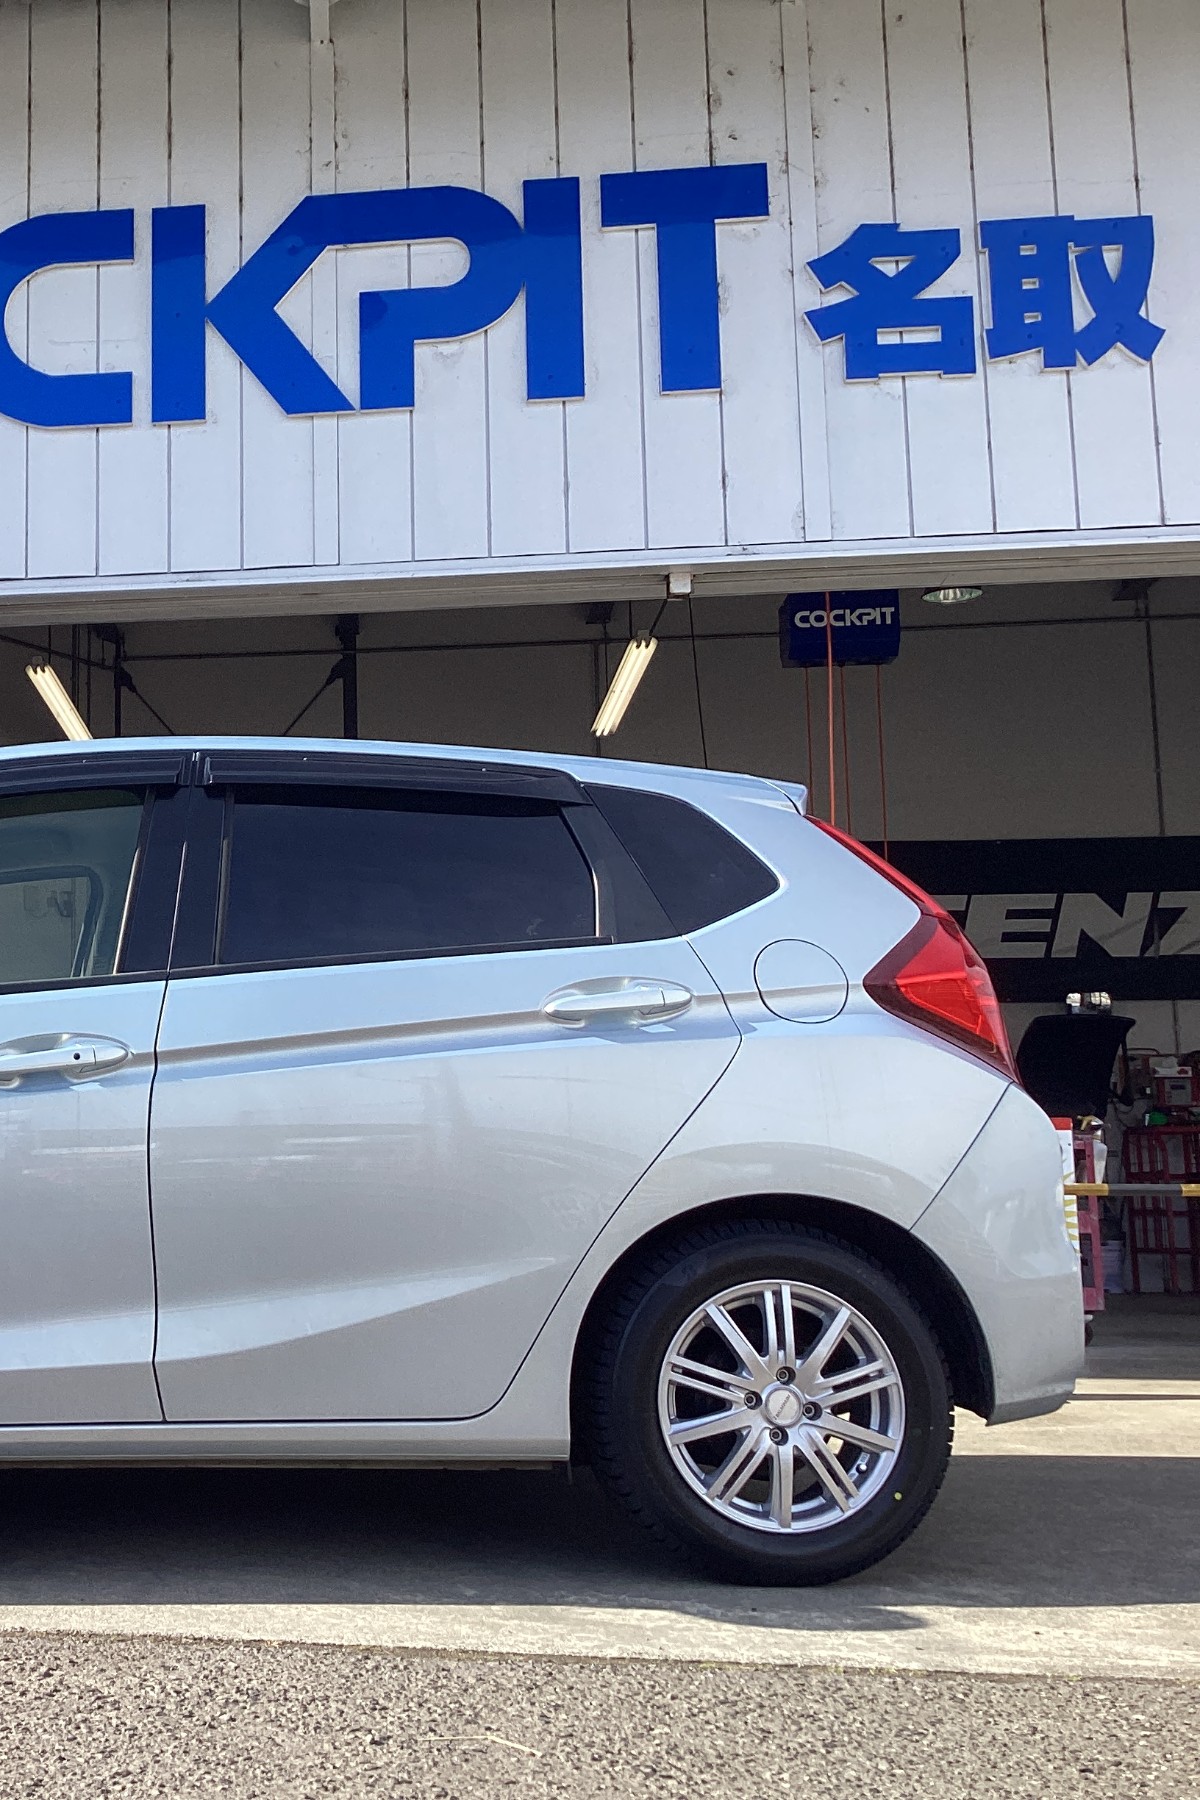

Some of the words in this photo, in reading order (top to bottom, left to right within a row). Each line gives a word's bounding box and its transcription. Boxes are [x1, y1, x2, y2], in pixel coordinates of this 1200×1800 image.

[805, 215, 1166, 379] 名取
[794, 606, 895, 629] COCKPIT
[932, 890, 1200, 959] ENZ
